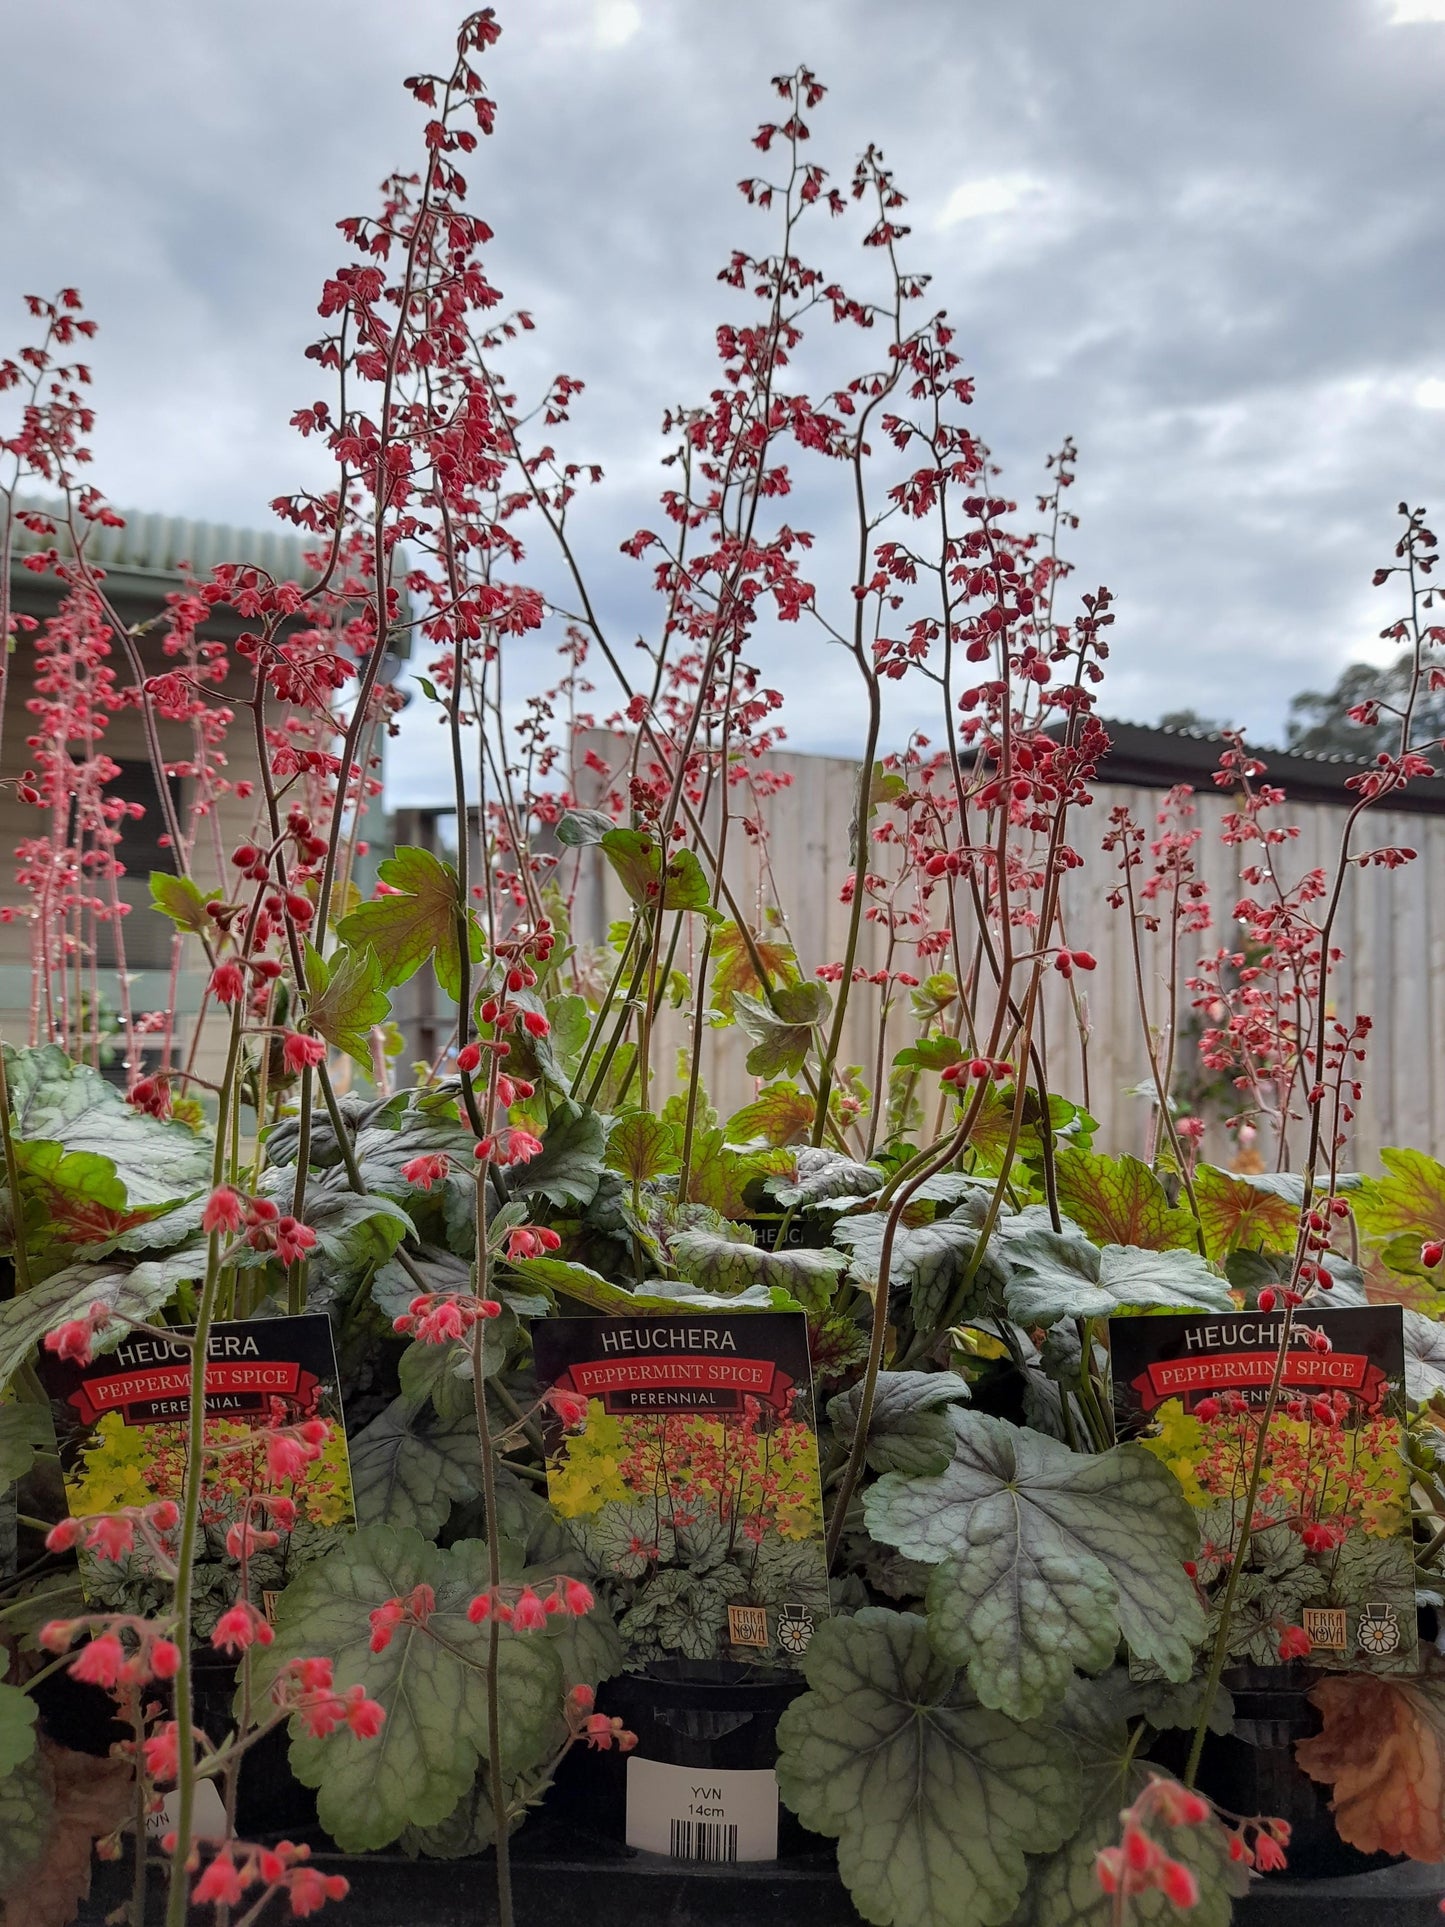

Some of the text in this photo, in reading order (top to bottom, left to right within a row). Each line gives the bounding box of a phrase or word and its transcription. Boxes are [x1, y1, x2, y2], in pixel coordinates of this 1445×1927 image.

[601, 1328, 737, 1352] HEUCHERA
[117, 1336, 260, 1366] HEUCERA
[581, 1364, 763, 1386] PEPPERMINT SPICE
[1296, 1360, 1355, 1378] SPICE
[96, 1370, 288, 1400] PEPPERMNT SPICE
[151, 1396, 241, 1415] PERENIAL
[631, 1392, 716, 1405] PERENNIAL
[731, 1608, 763, 1624] TERRA
[1306, 1611, 1343, 1627] TERRA
[733, 1623, 766, 1641] NOVA
[1308, 1626, 1343, 1643] NOVA
[691, 1786, 722, 1800] YVN
[688, 1803, 724, 1817] 14cm
